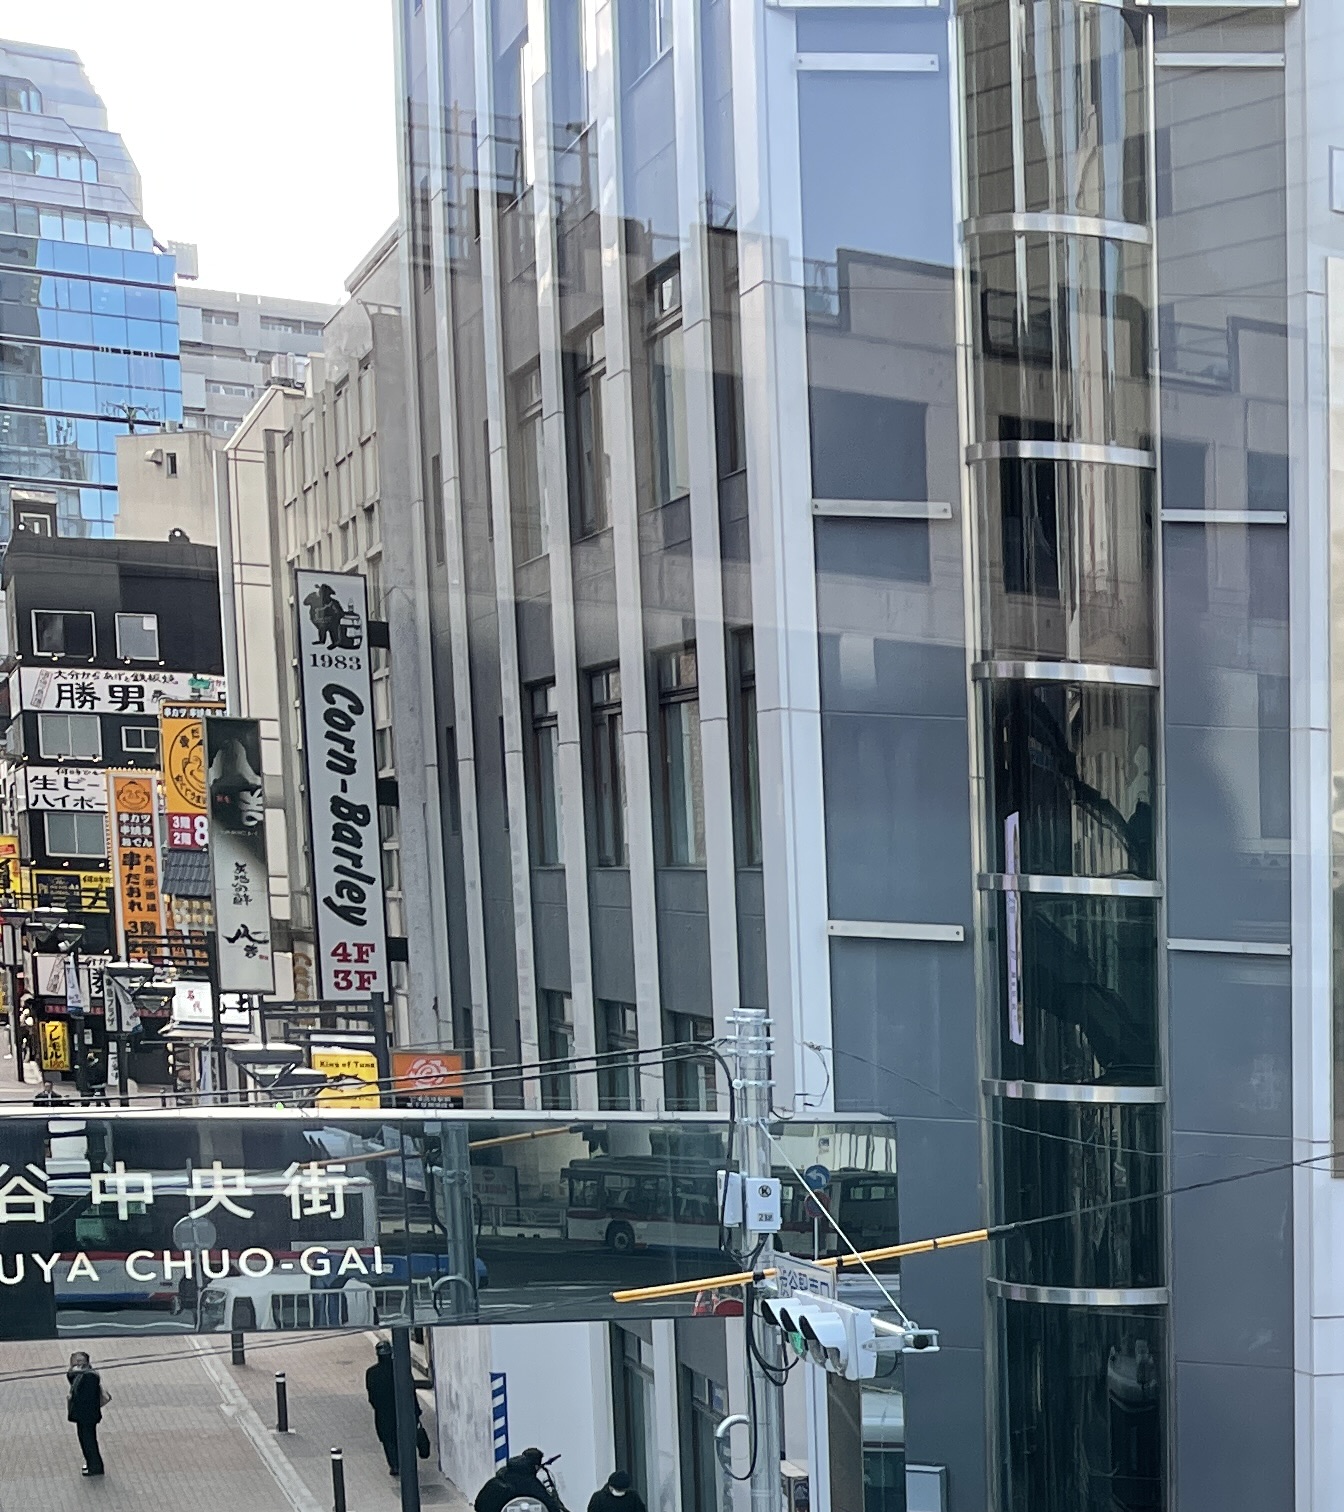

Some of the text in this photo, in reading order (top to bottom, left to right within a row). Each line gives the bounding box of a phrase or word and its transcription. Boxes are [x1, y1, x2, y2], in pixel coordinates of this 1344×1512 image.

[310, 653, 362, 671] 1983
[55, 682, 145, 712] 勝男
[320, 682, 377, 927] Corn-Barley
[330, 941, 376, 964] 4F
[333, 969, 377, 992] 3F
[0, 1160, 349, 1223] 谷中央街
[0, 1246, 383, 1285] UYA CHUO-GAI
